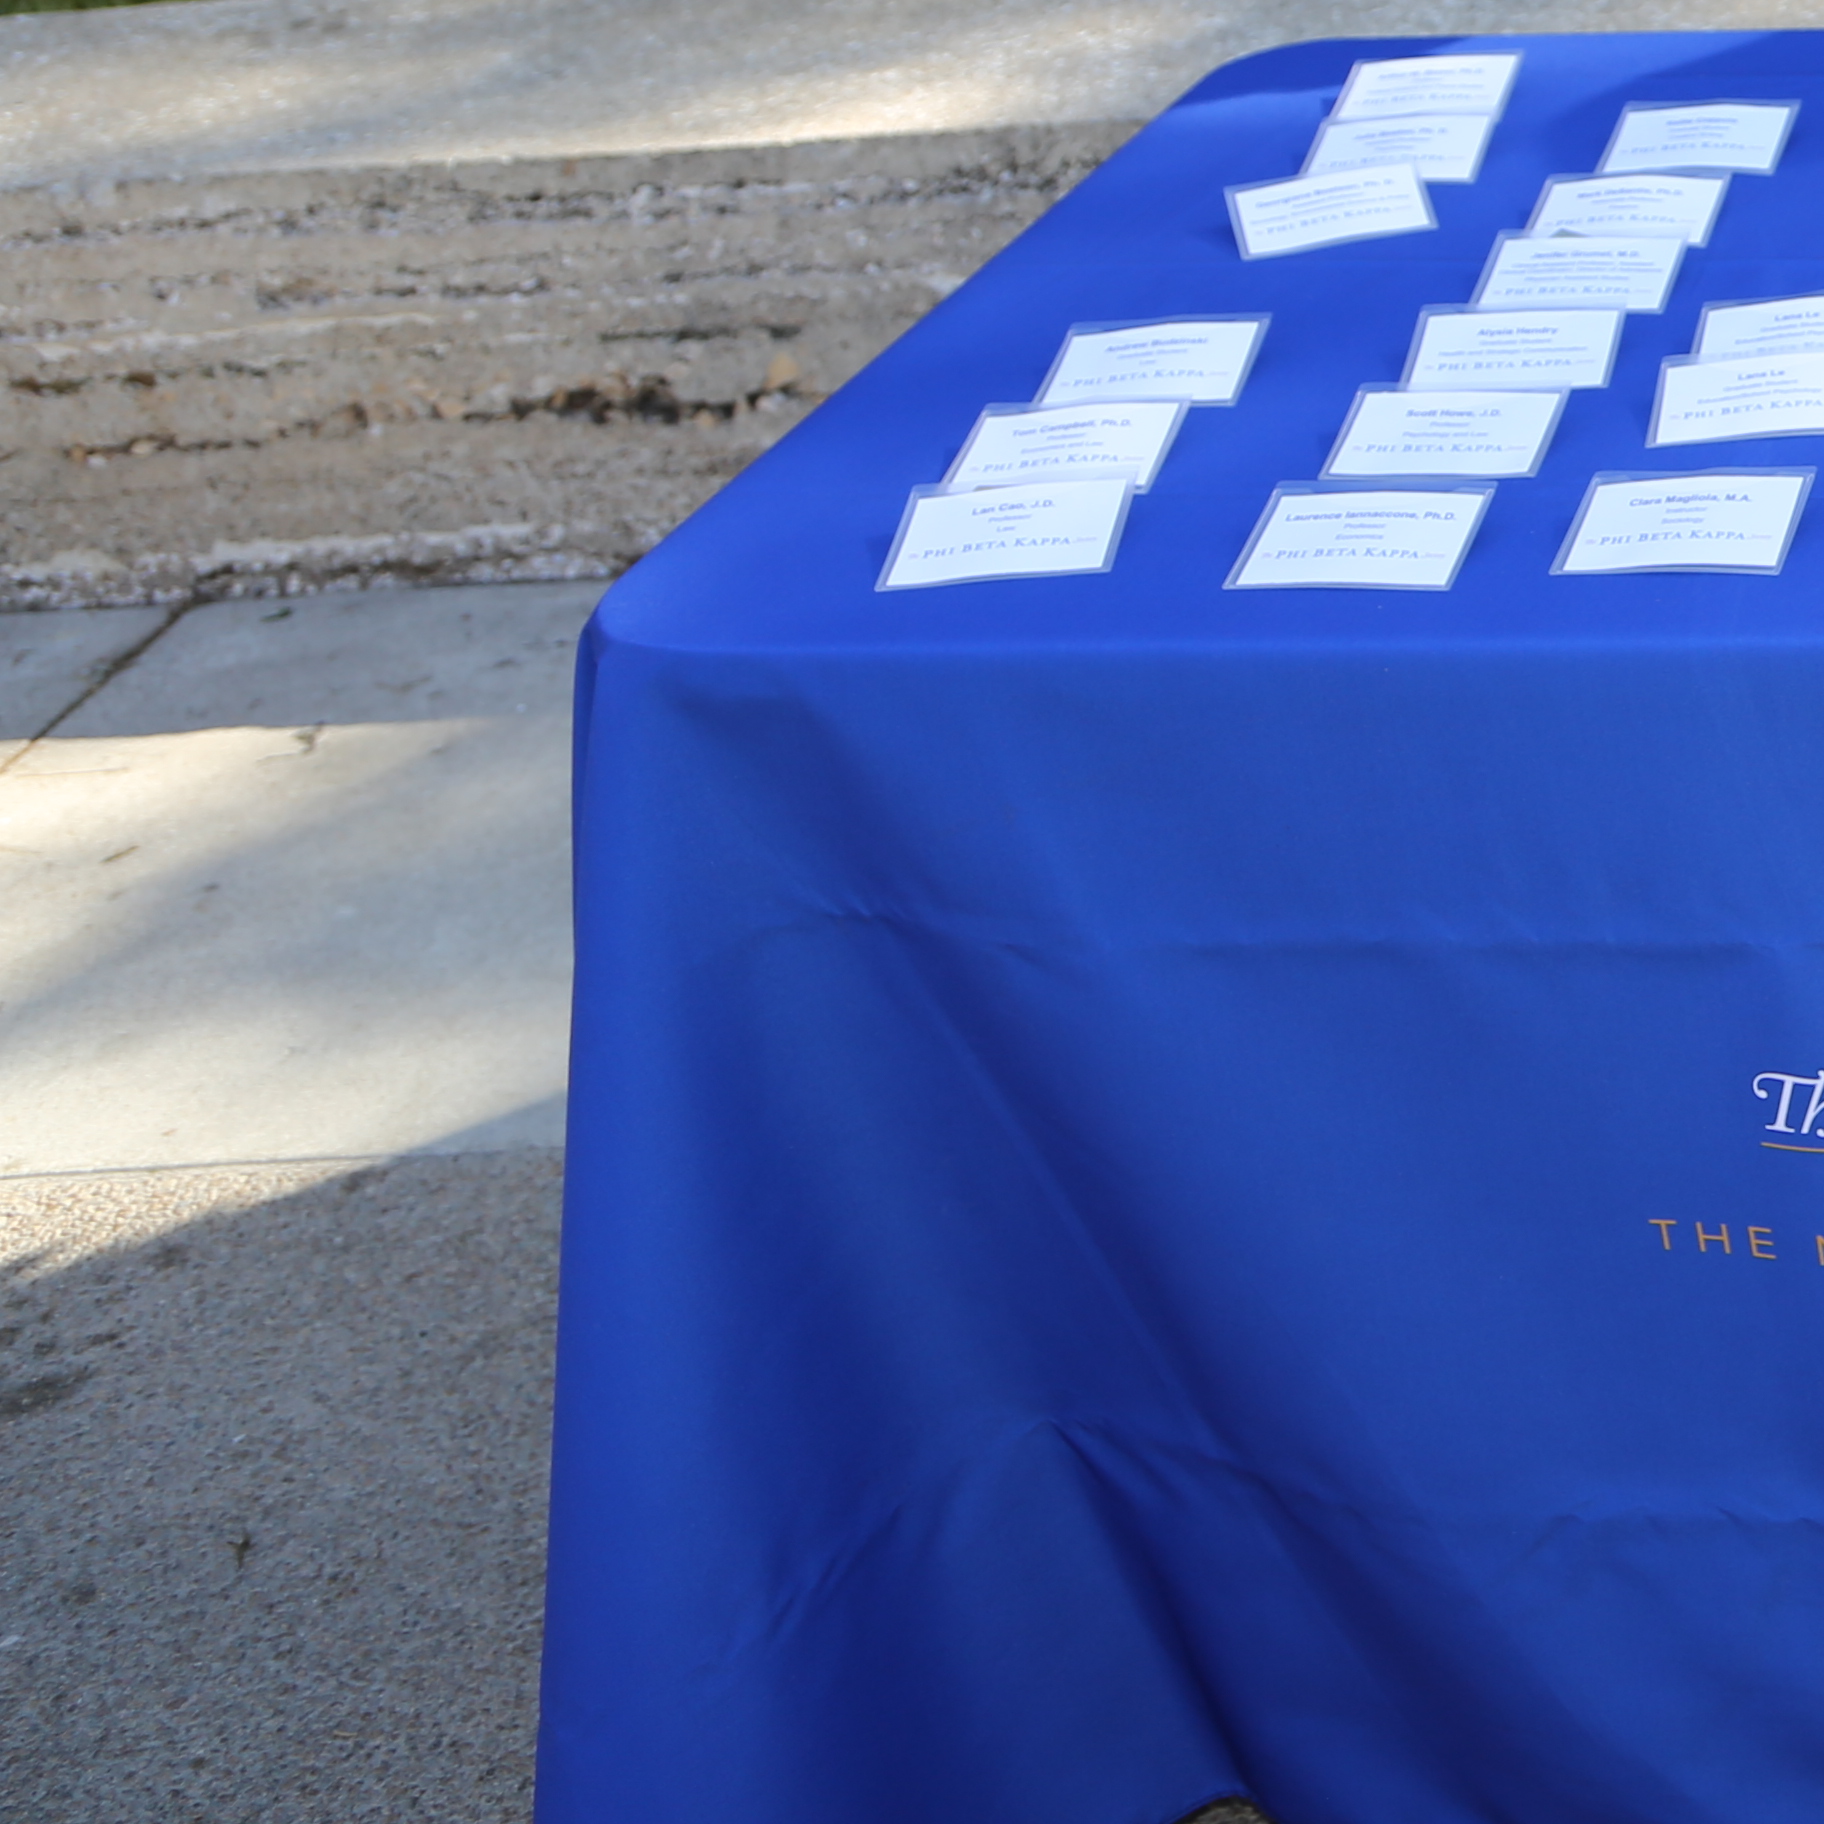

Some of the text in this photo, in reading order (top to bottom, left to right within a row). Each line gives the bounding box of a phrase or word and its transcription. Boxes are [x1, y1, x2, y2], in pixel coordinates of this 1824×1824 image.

[1721, 403, 1763, 415] BETA
[1770, 399, 1823, 409] KAPPA
[1365, 444, 1503, 452] PHI BETA KAPPA
[1019, 457, 1059, 469] BETA
[1066, 454, 1118, 463] KAPPA
[1600, 529, 1745, 546] PHI BETA KAPPA
[922, 536, 1071, 559] PHI BETA KAPPA
[1276, 547, 1419, 559] PHI BETA KAPPA
[1649, 1217, 1780, 1262] THE
